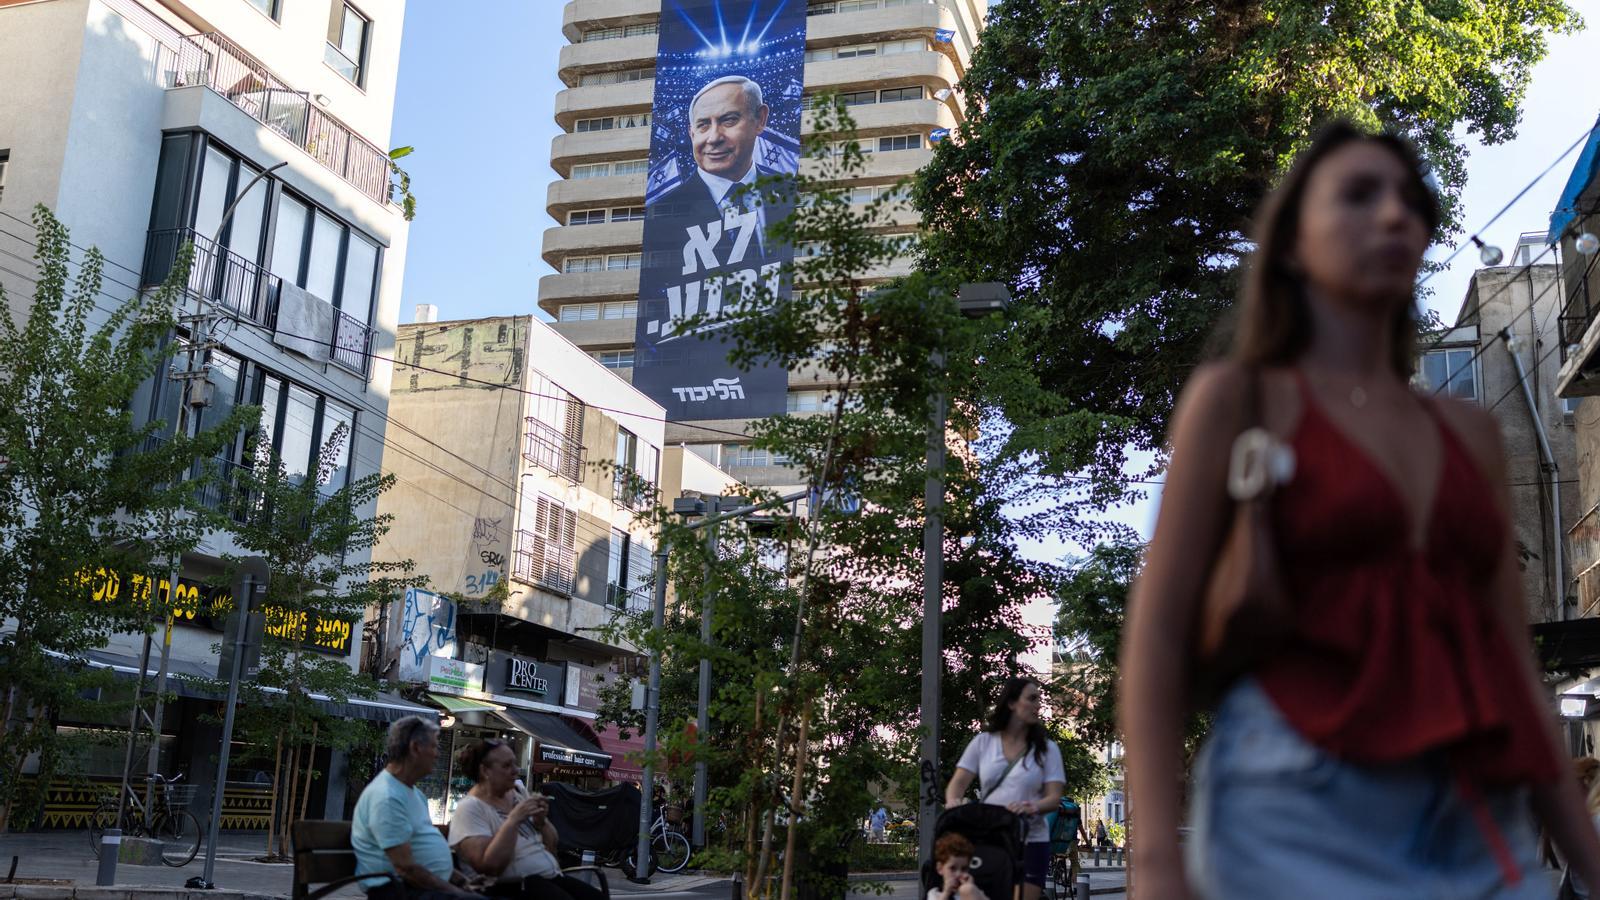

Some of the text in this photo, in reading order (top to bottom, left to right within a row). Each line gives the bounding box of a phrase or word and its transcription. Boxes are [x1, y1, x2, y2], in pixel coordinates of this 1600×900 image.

[682, 206, 758, 275] לא
[672, 377, 745, 402] הליכוד
[510, 658, 537, 686] PRO
[515, 674, 548, 692] CENTER
[542, 750, 573, 761] professional
[574, 753, 585, 762] hair
